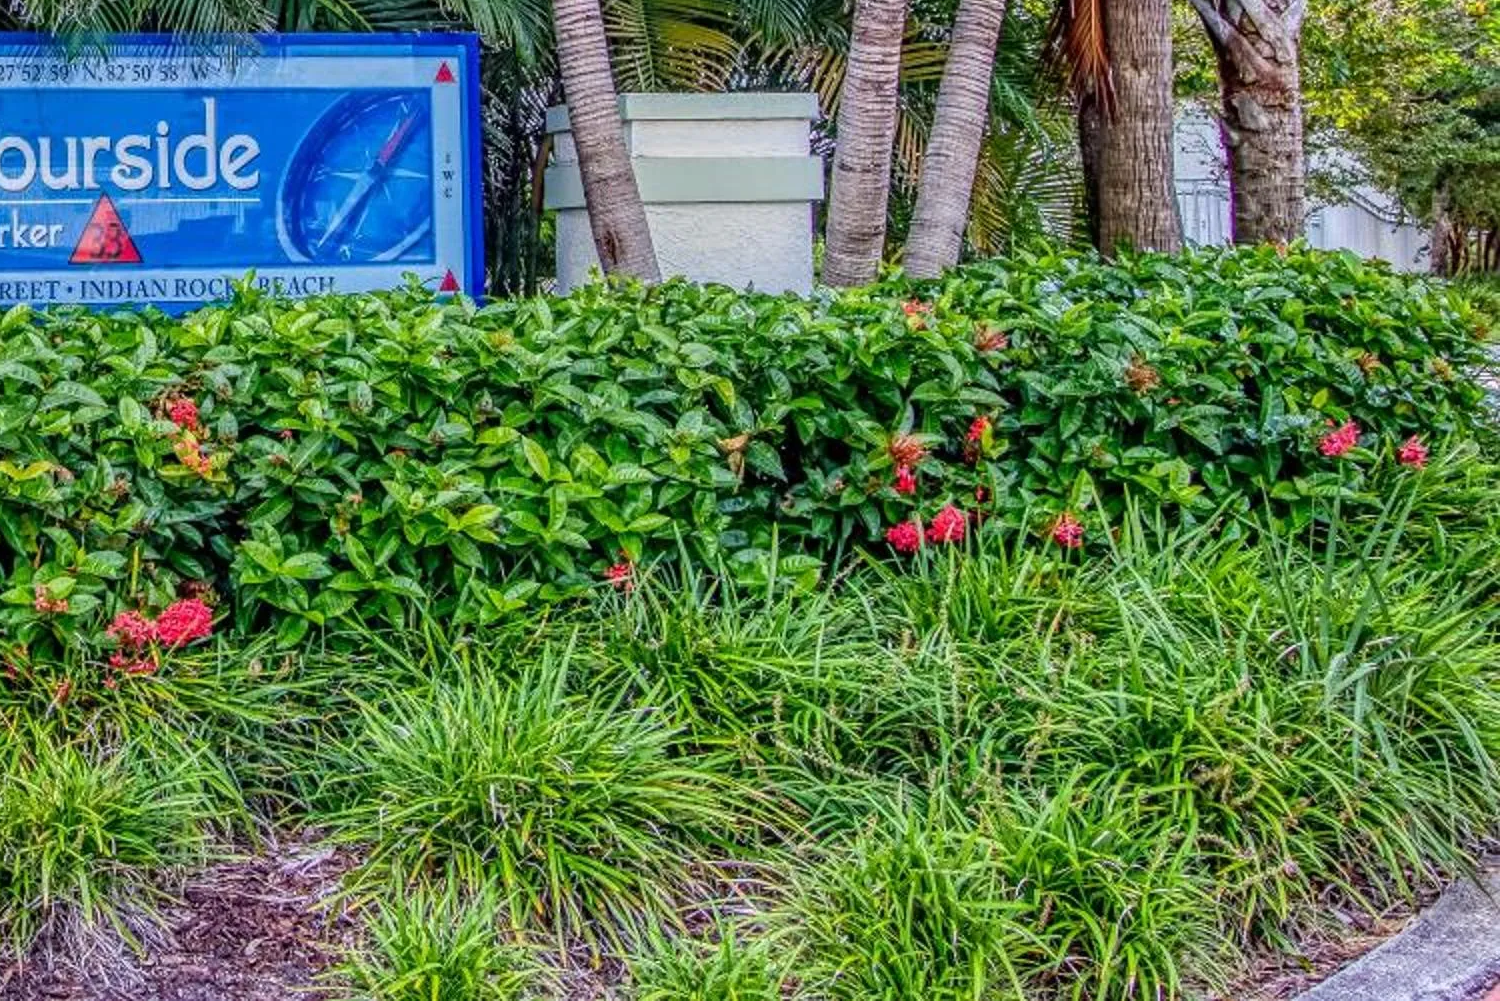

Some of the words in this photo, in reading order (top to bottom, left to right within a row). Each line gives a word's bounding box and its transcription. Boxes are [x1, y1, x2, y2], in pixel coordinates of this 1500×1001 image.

[79, 277, 168, 299] INDIAN
[173, 276, 239, 301] ROCK
[258, 275, 337, 299] BEACH
